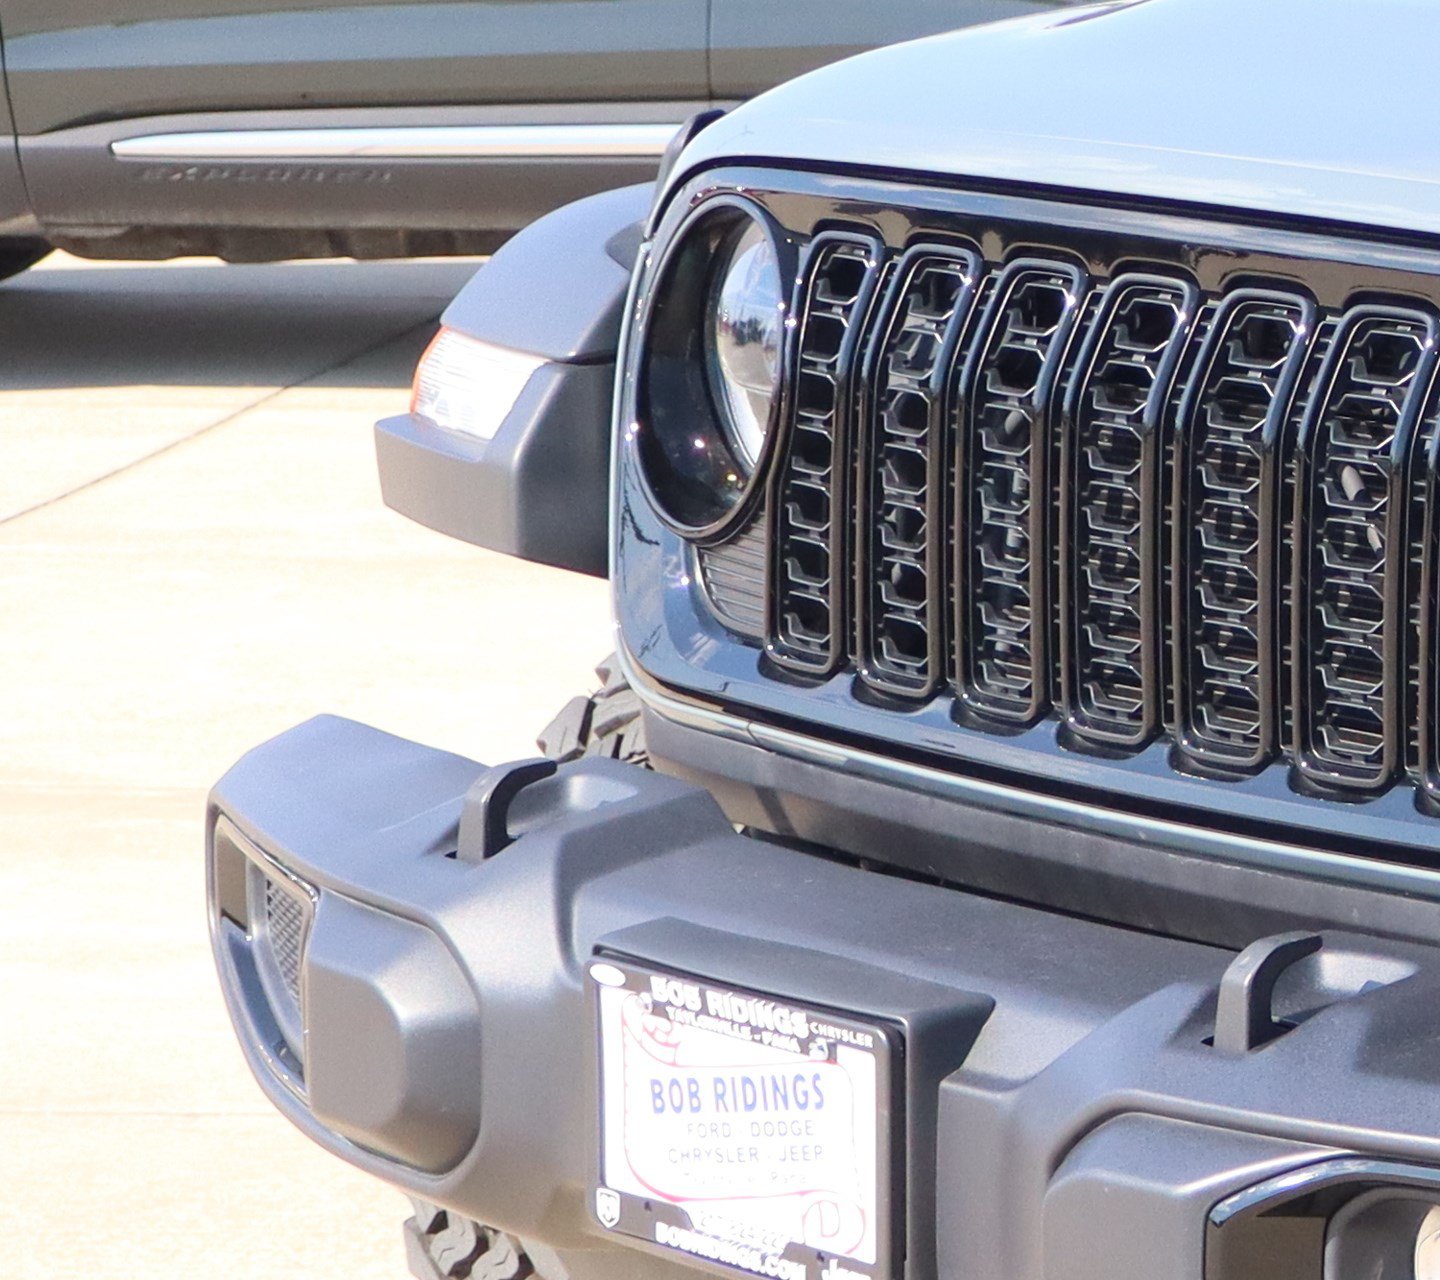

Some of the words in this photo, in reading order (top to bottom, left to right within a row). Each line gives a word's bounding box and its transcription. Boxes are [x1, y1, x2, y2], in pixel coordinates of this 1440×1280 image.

[649, 975, 702, 1010] BOB
[705, 988, 811, 1040] RIDINGS
[810, 1021, 873, 1048] CHRYSLER
[649, 1075, 702, 1115] BOB
[712, 1071, 826, 1113] RIDINGS
[686, 1120, 732, 1140] FORD
[750, 1119, 814, 1138] DODGE
[667, 1145, 760, 1165] CHRYSLER
[778, 1143, 824, 1163] JEEP
